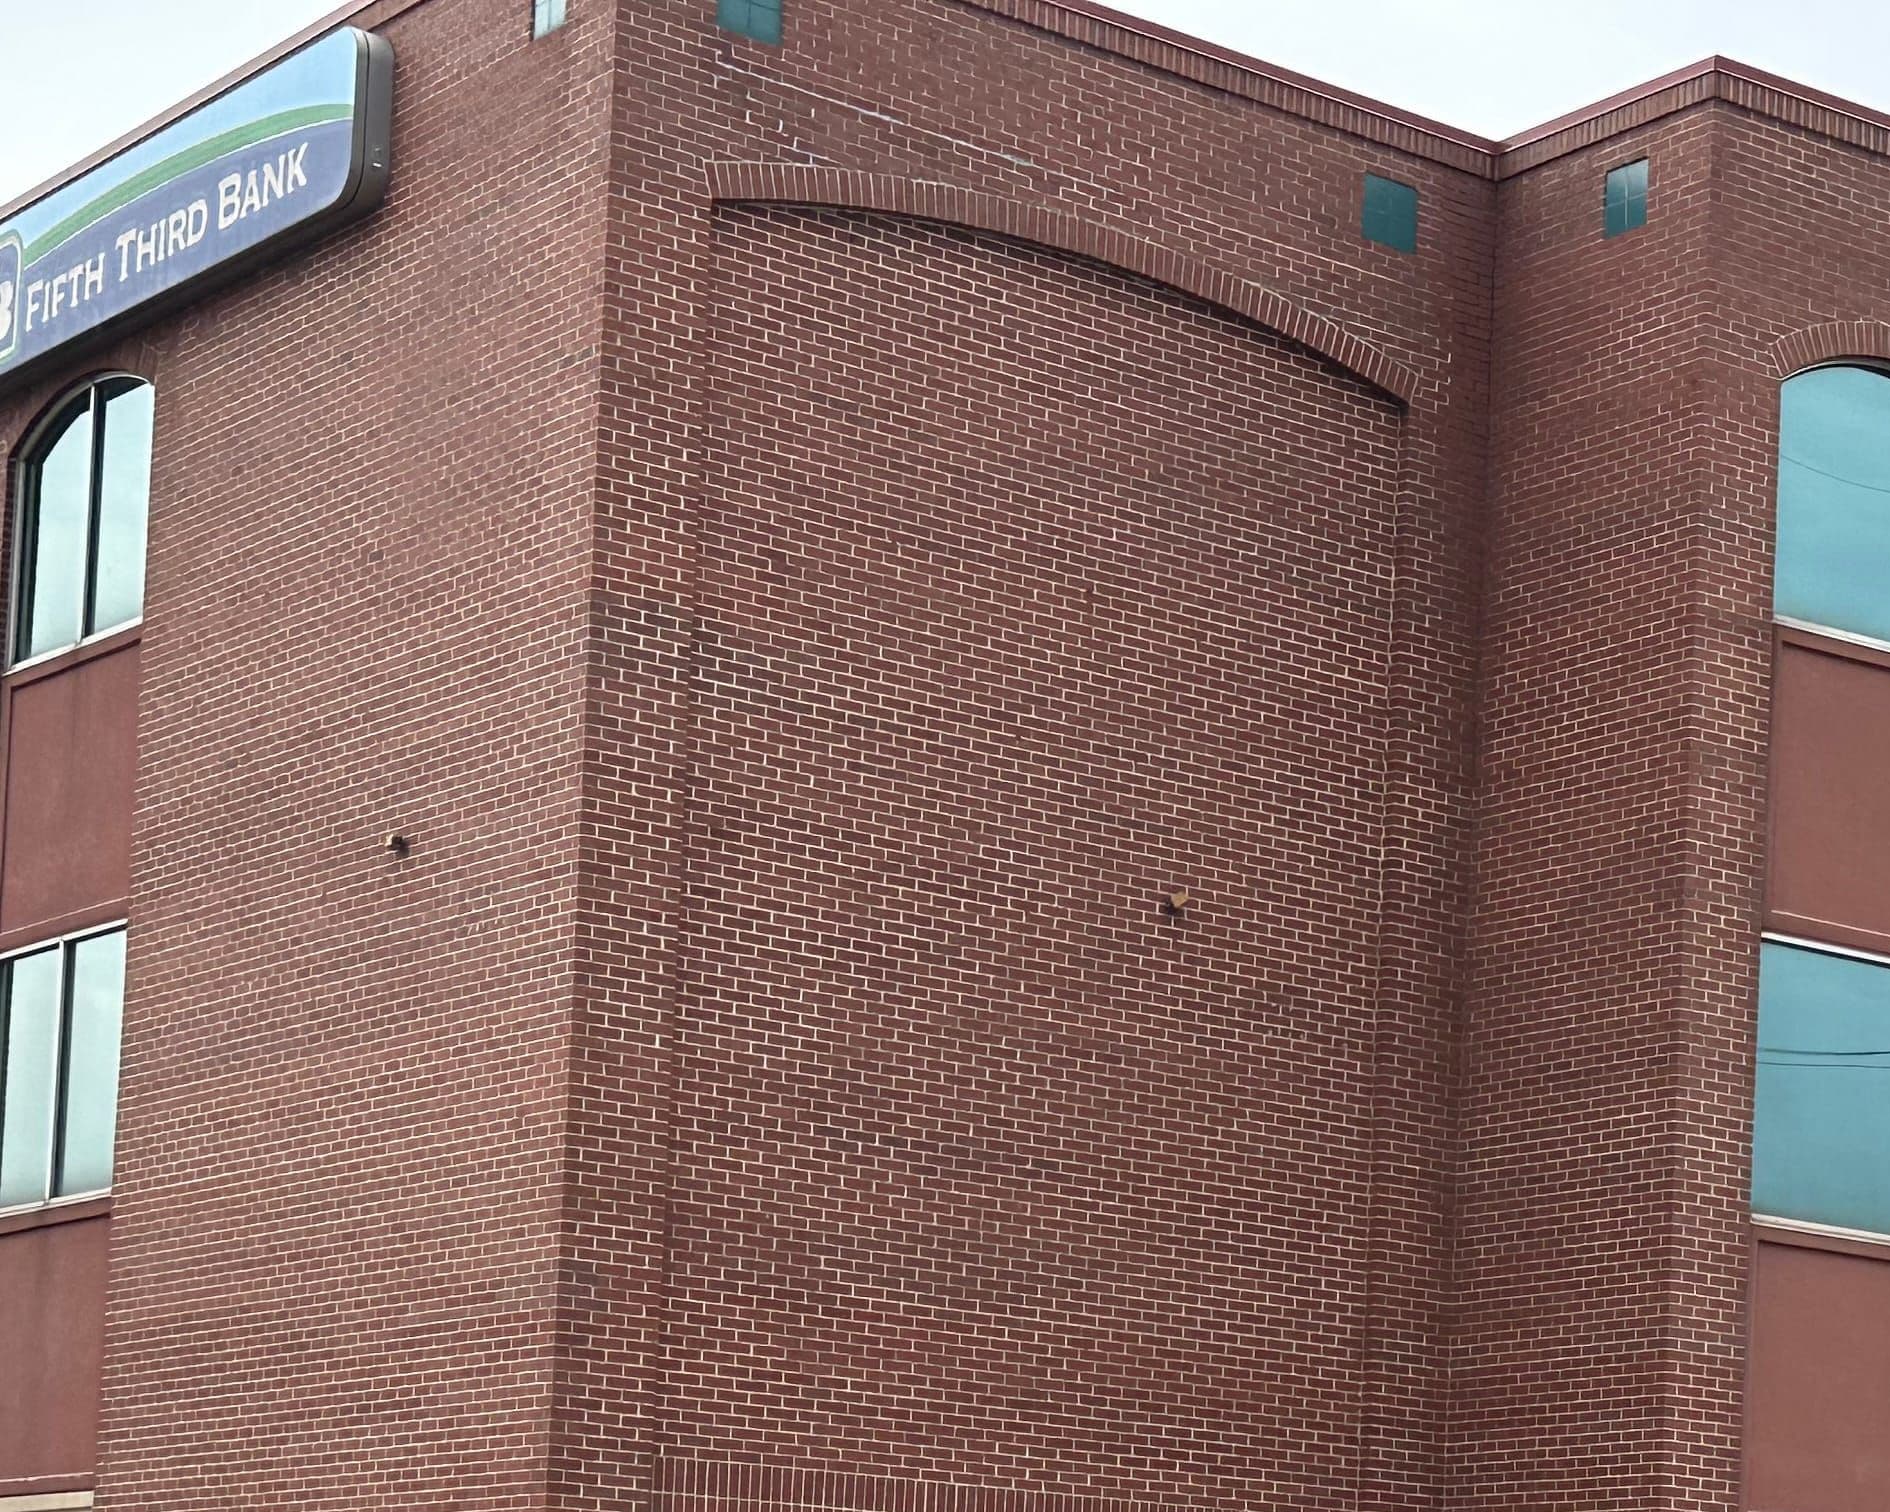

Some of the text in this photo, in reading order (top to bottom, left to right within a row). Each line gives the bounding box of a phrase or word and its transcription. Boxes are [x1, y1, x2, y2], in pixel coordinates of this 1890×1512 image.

[26, 143, 308, 332] FIFTH THIRD BANK
